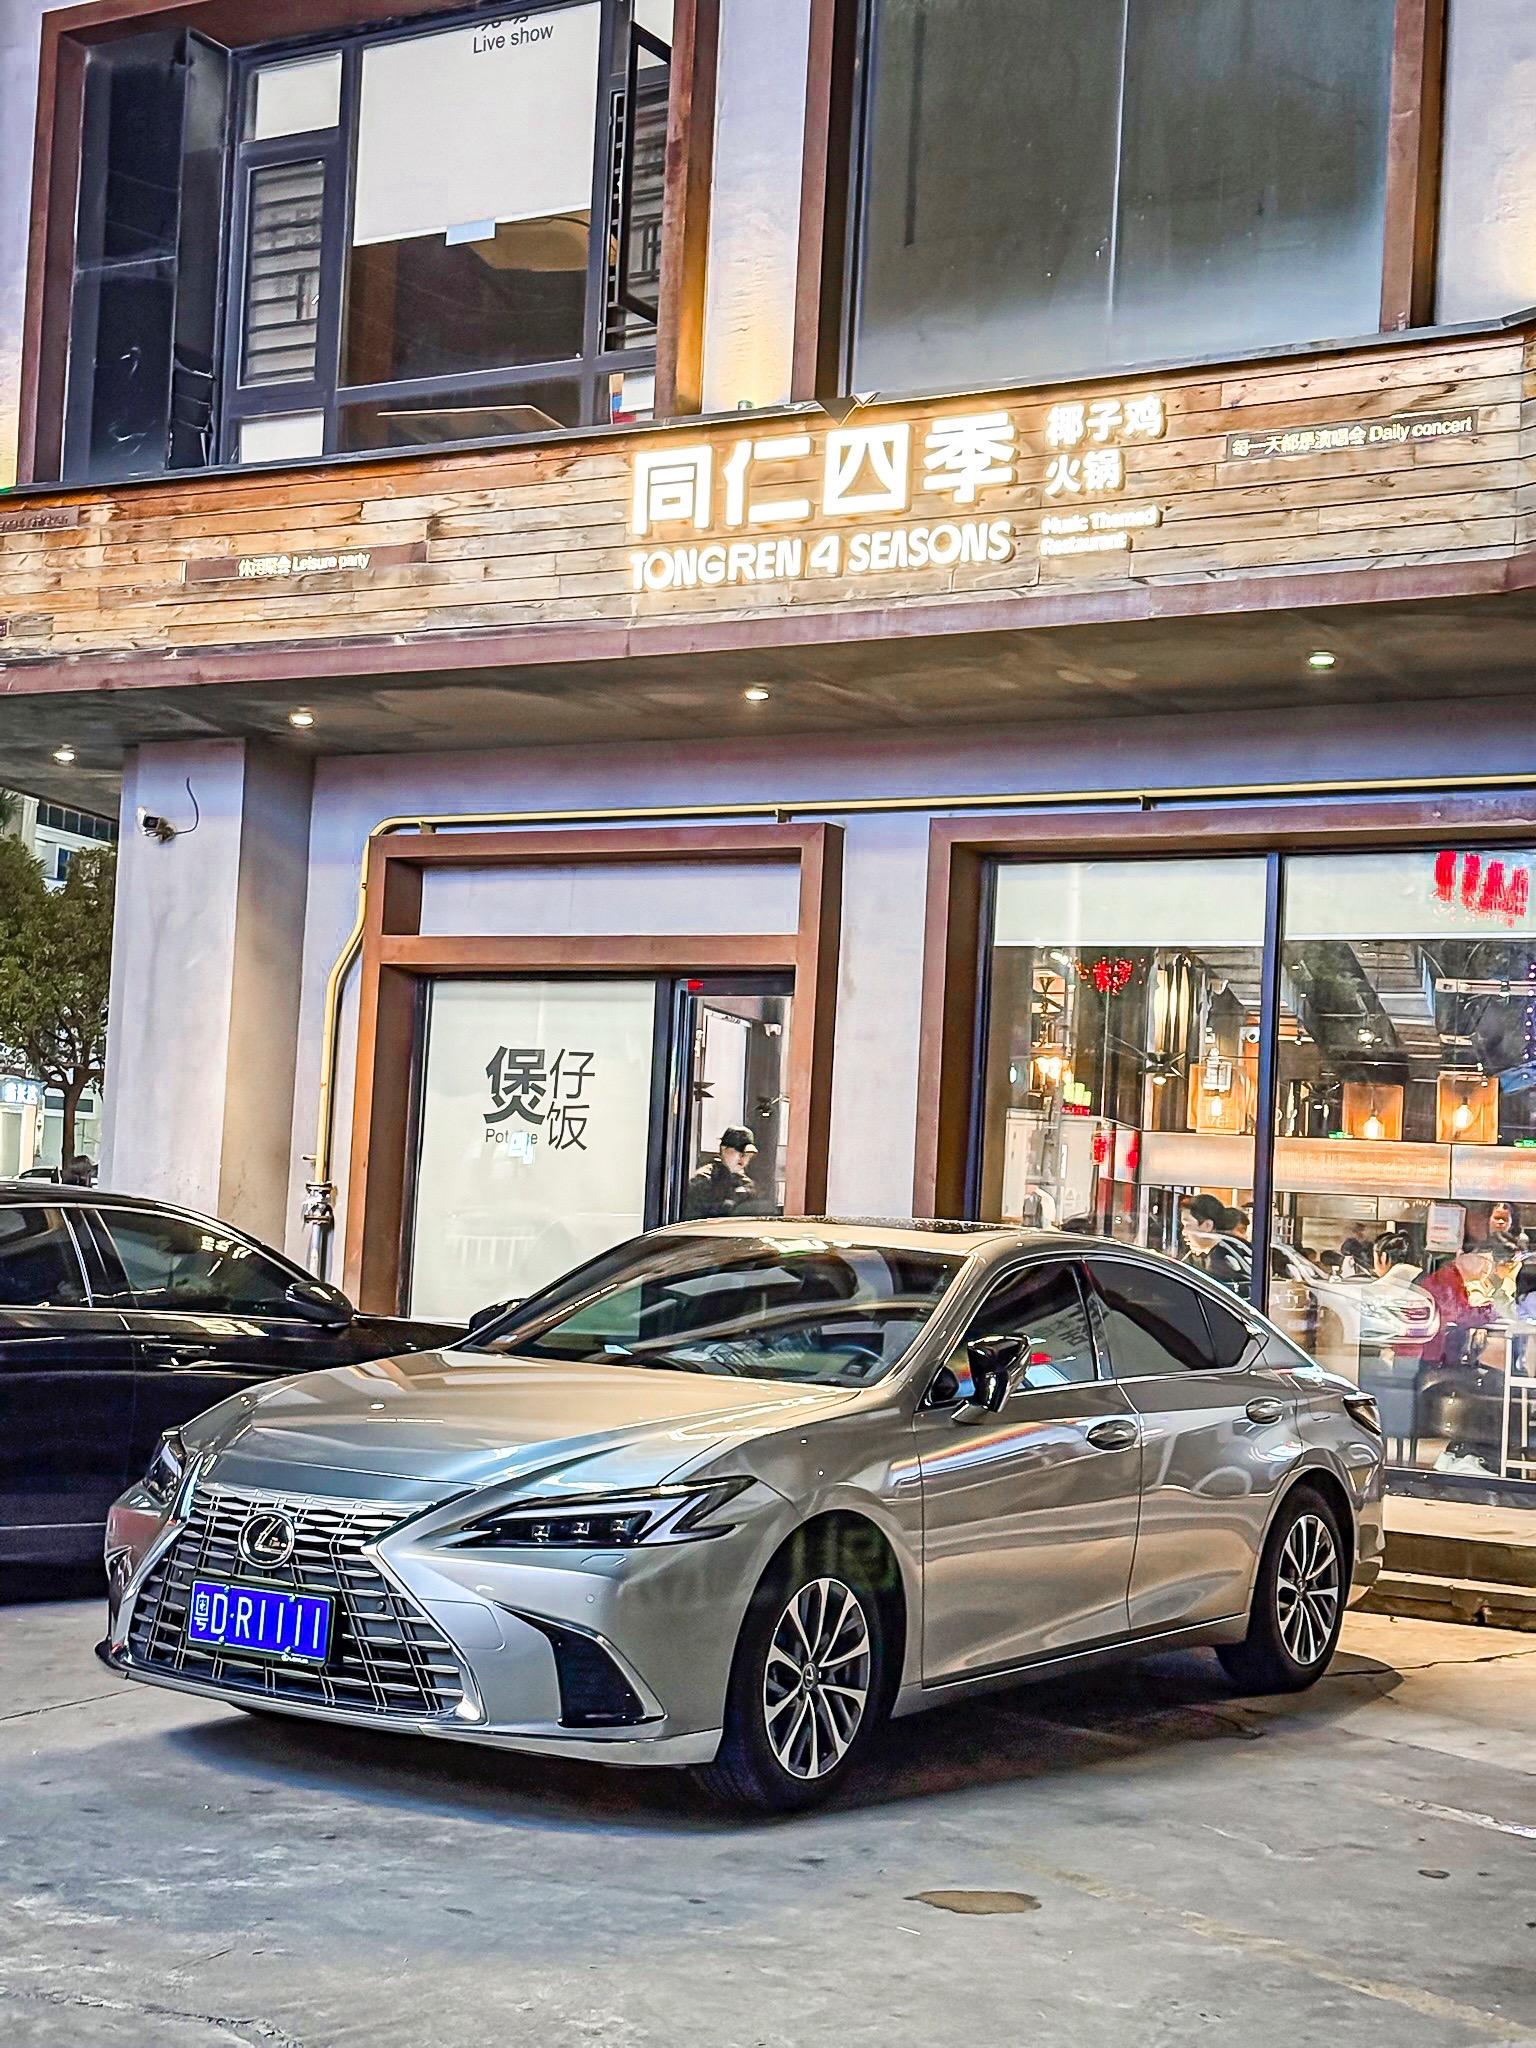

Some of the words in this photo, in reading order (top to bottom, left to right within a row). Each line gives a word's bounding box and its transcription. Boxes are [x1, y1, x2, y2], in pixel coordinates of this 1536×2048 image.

[474, 35, 506, 54] Live
[510, 25, 554, 46] show
[1045, 394, 1163, 447] 椰子鸡
[1368, 424, 1411, 443] Daily
[1411, 415, 1473, 438] concert
[631, 410, 1017, 536] 同仁四季
[1044, 448, 1122, 496] 火锅
[292, 555, 338, 572] Leisure
[338, 552, 371, 570] party
[629, 538, 803, 591] TONGREN
[809, 535, 841, 579] 4
[847, 519, 1016, 573] SEASONS
[193, 1591, 322, 1649] 粤D·R1111
